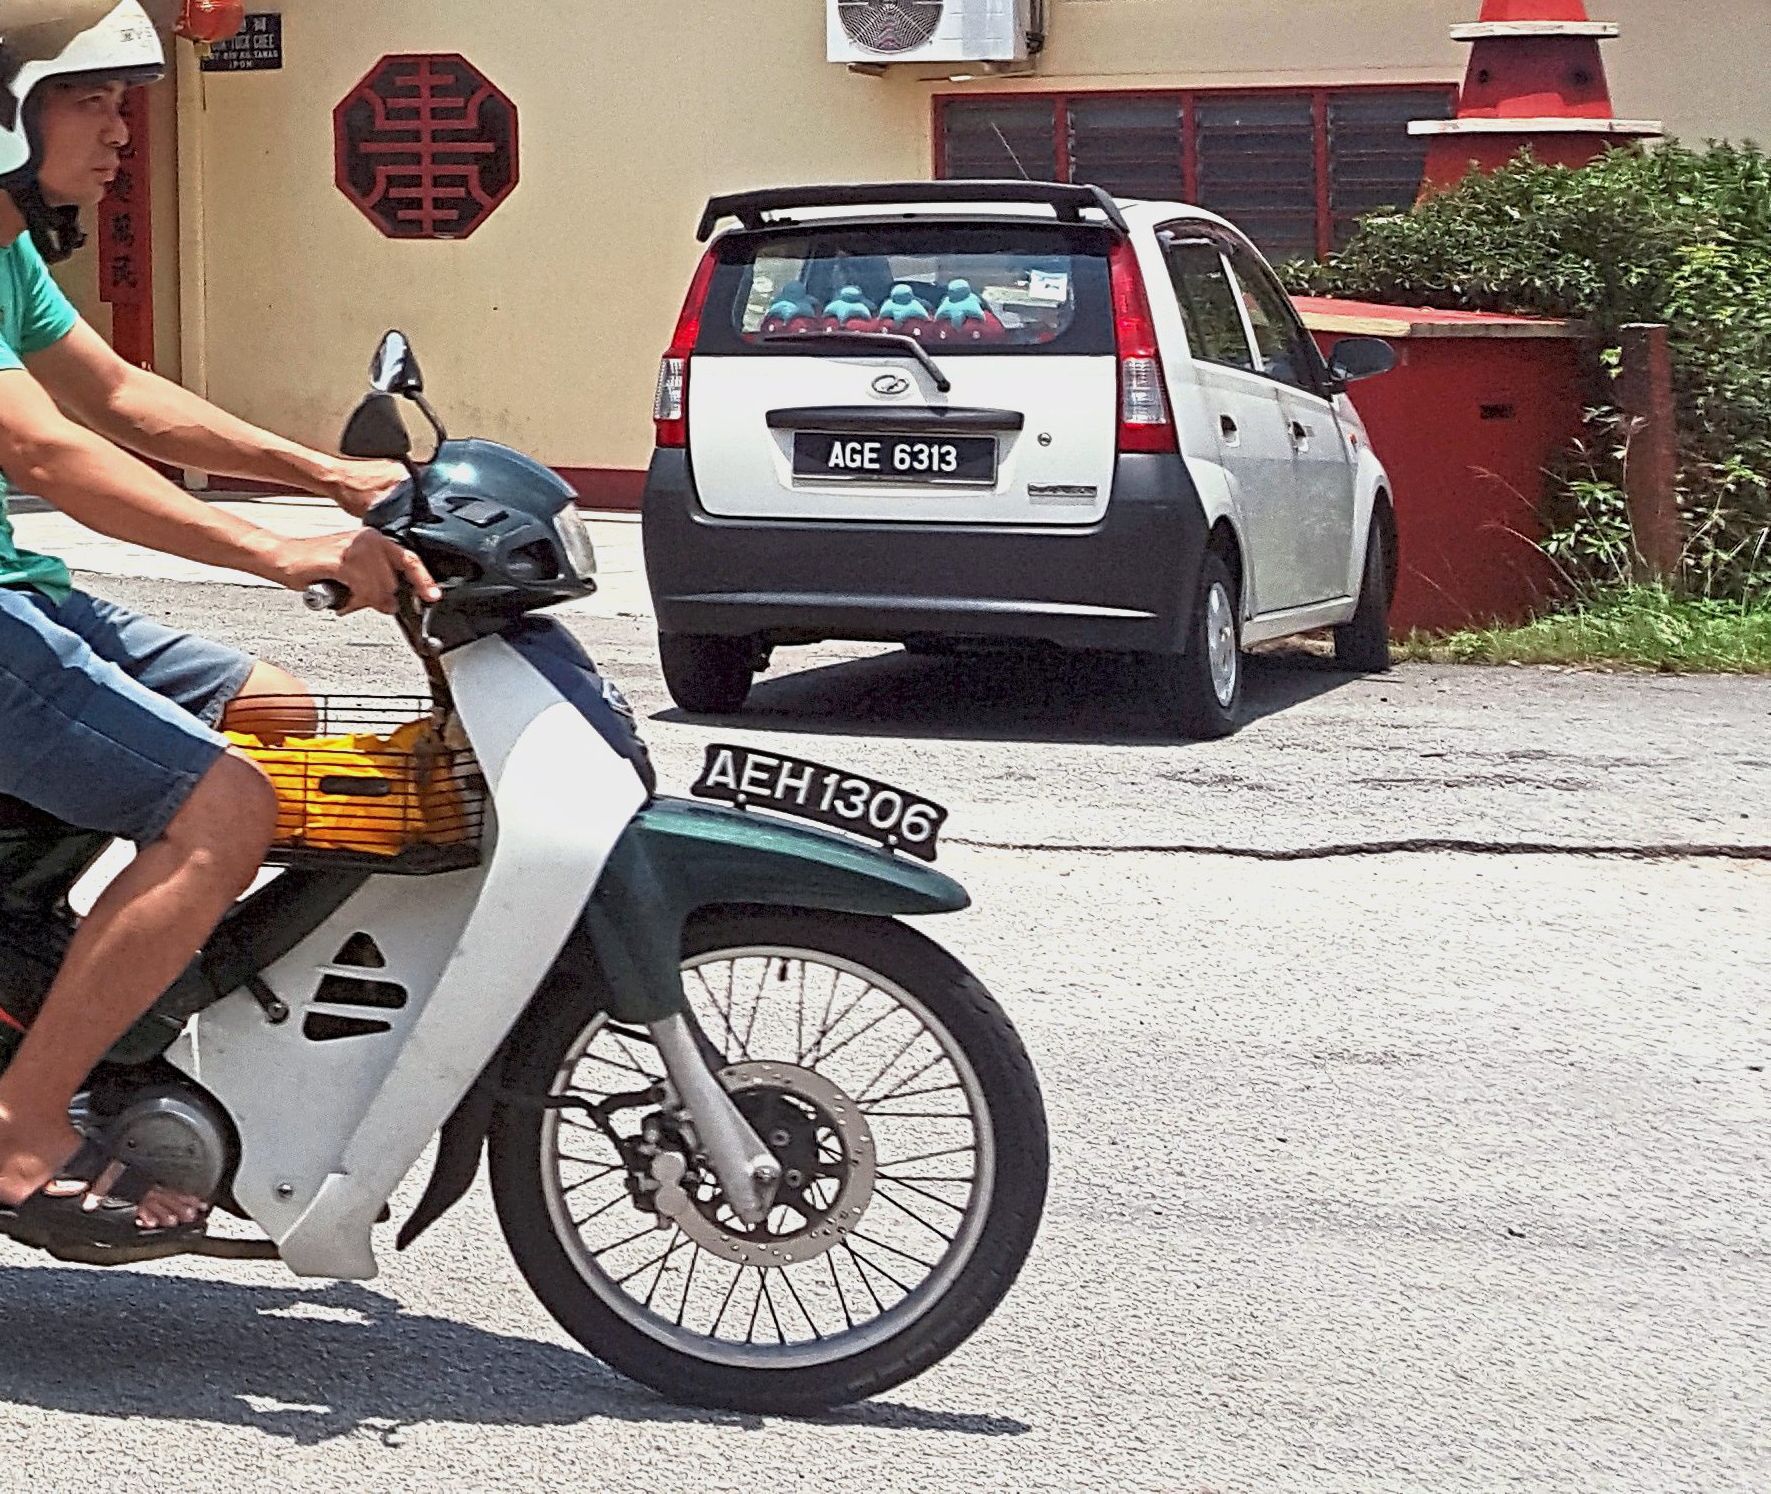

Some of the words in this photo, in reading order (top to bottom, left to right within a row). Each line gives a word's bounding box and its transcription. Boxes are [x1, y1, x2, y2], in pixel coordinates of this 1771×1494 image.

[828, 441, 881, 469] AGE
[894, 444, 957, 472] 6313
[706, 749, 814, 805] AEH
[820, 773, 939, 842] 1306
